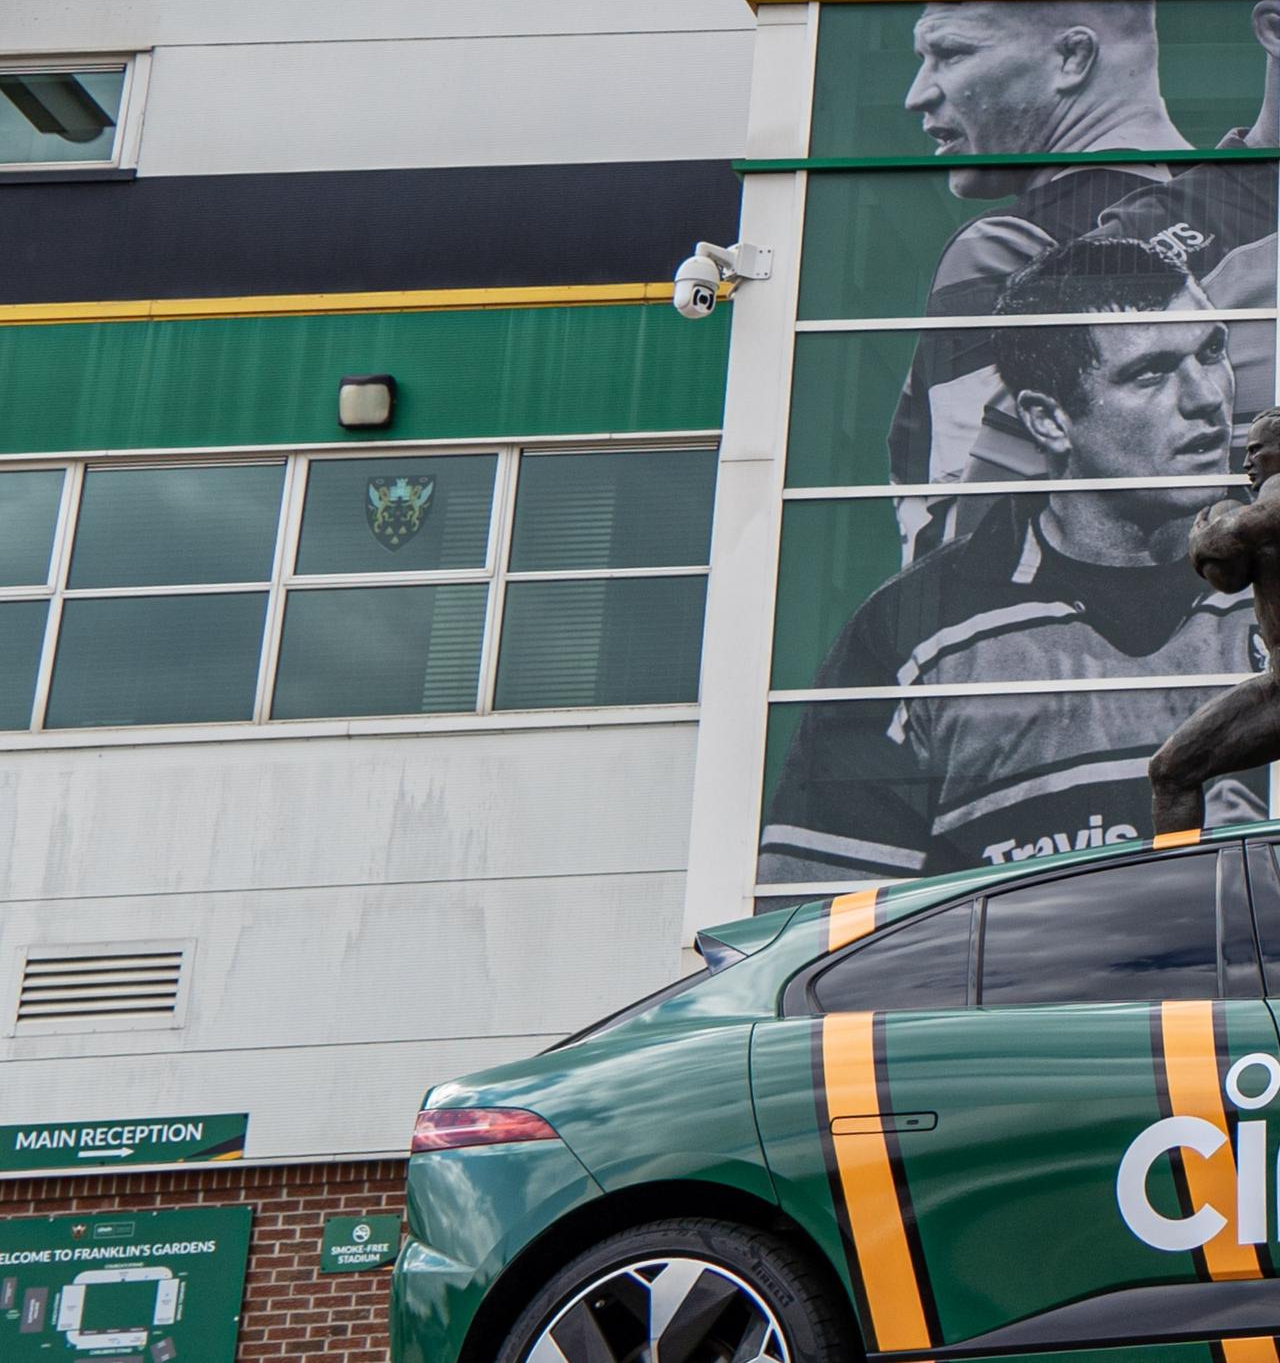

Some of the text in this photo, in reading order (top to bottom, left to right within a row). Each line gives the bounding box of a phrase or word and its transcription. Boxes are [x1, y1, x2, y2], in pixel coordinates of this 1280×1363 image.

[16, 1123, 204, 1150] MAIN RECEPTION
[0, 1240, 216, 1265] ELCOME TO FRANKLIN'S GARDENS
[331, 1243, 389, 1255] SMOKE-FREE
[338, 1253, 380, 1264] STADIUM
